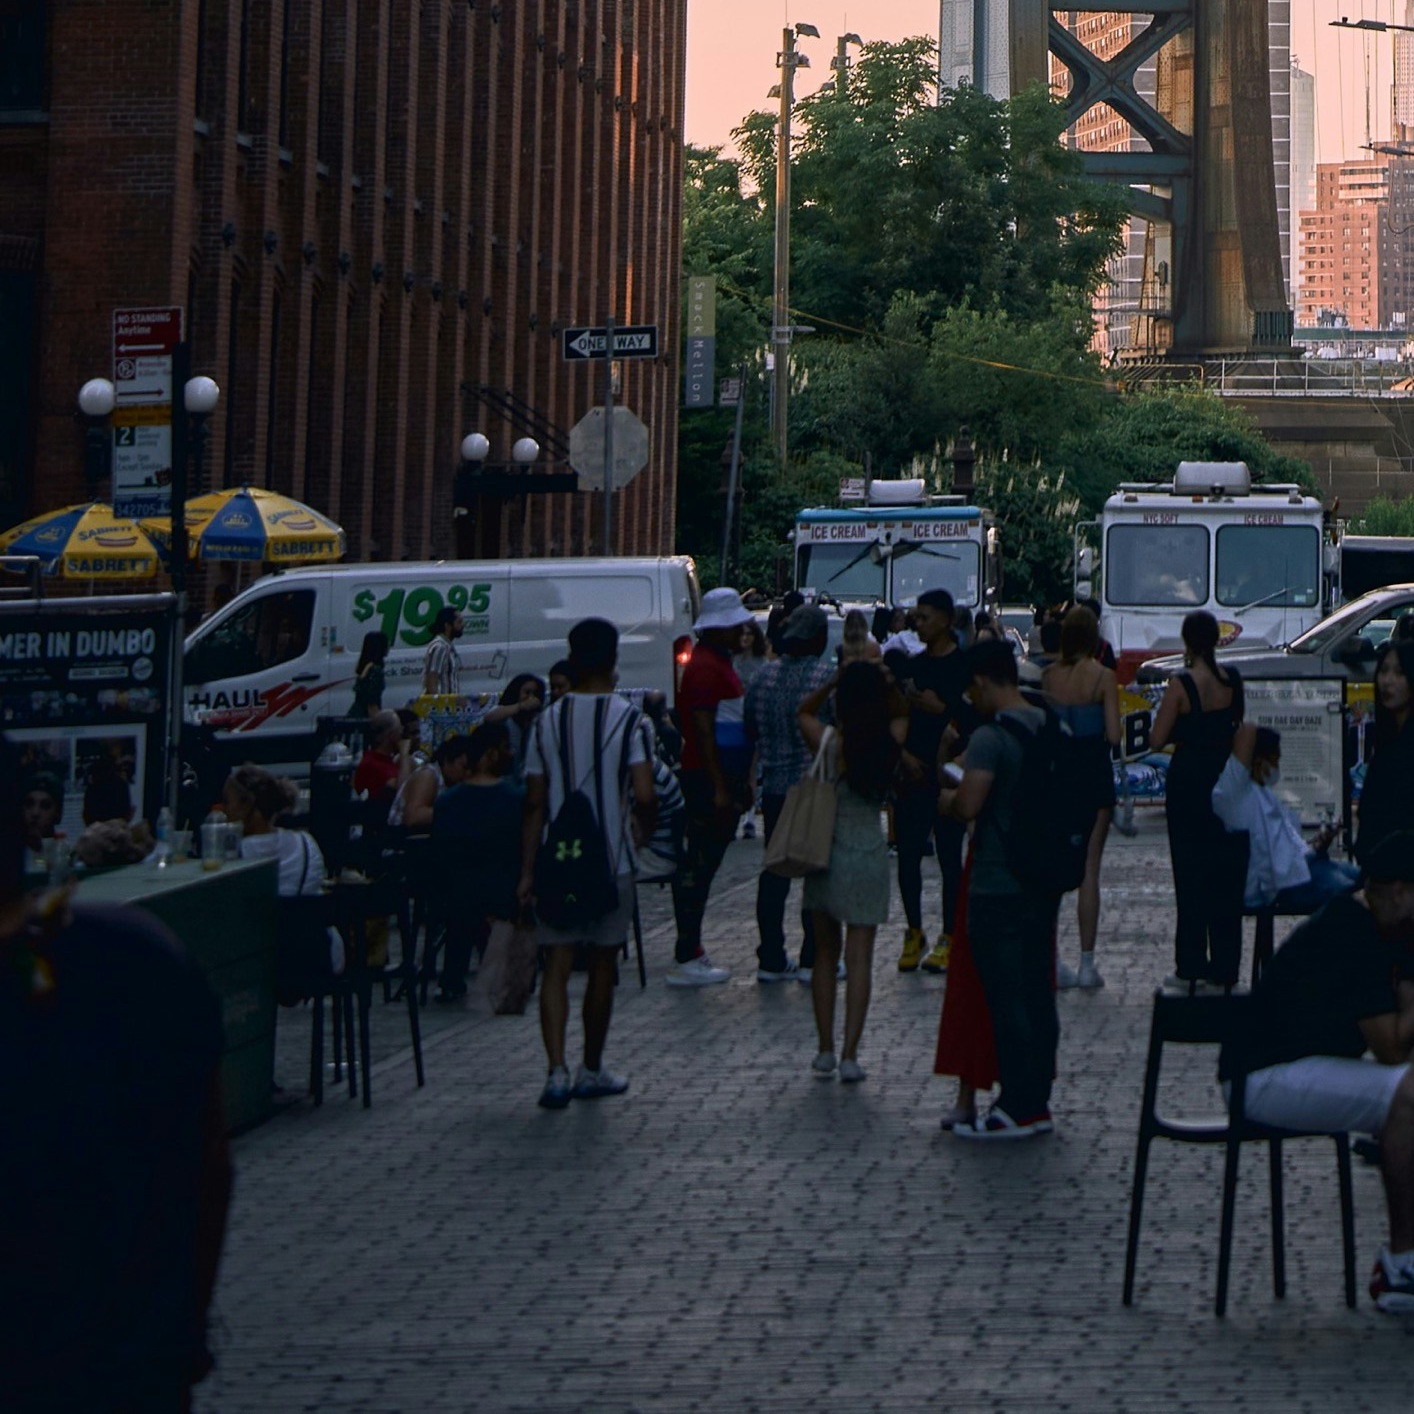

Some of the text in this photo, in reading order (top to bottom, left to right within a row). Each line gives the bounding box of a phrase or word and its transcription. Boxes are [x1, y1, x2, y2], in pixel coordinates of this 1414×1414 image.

[694, 282, 705, 332] Smack
[117, 311, 172, 323] NO STANDING
[116, 325, 152, 336] Anytime
[578, 335, 645, 351] ONE WAY
[692, 340, 704, 402] Mellon
[119, 427, 131, 444] 2
[811, 524, 866, 540] ICE CREAM
[913, 523, 968, 538] ICE CREAM
[271, 539, 335, 555] SABRETT
[67, 556, 151, 572] SABRETT
[47, 631, 71, 658] IN
[76, 628, 156, 657] DUMBO
